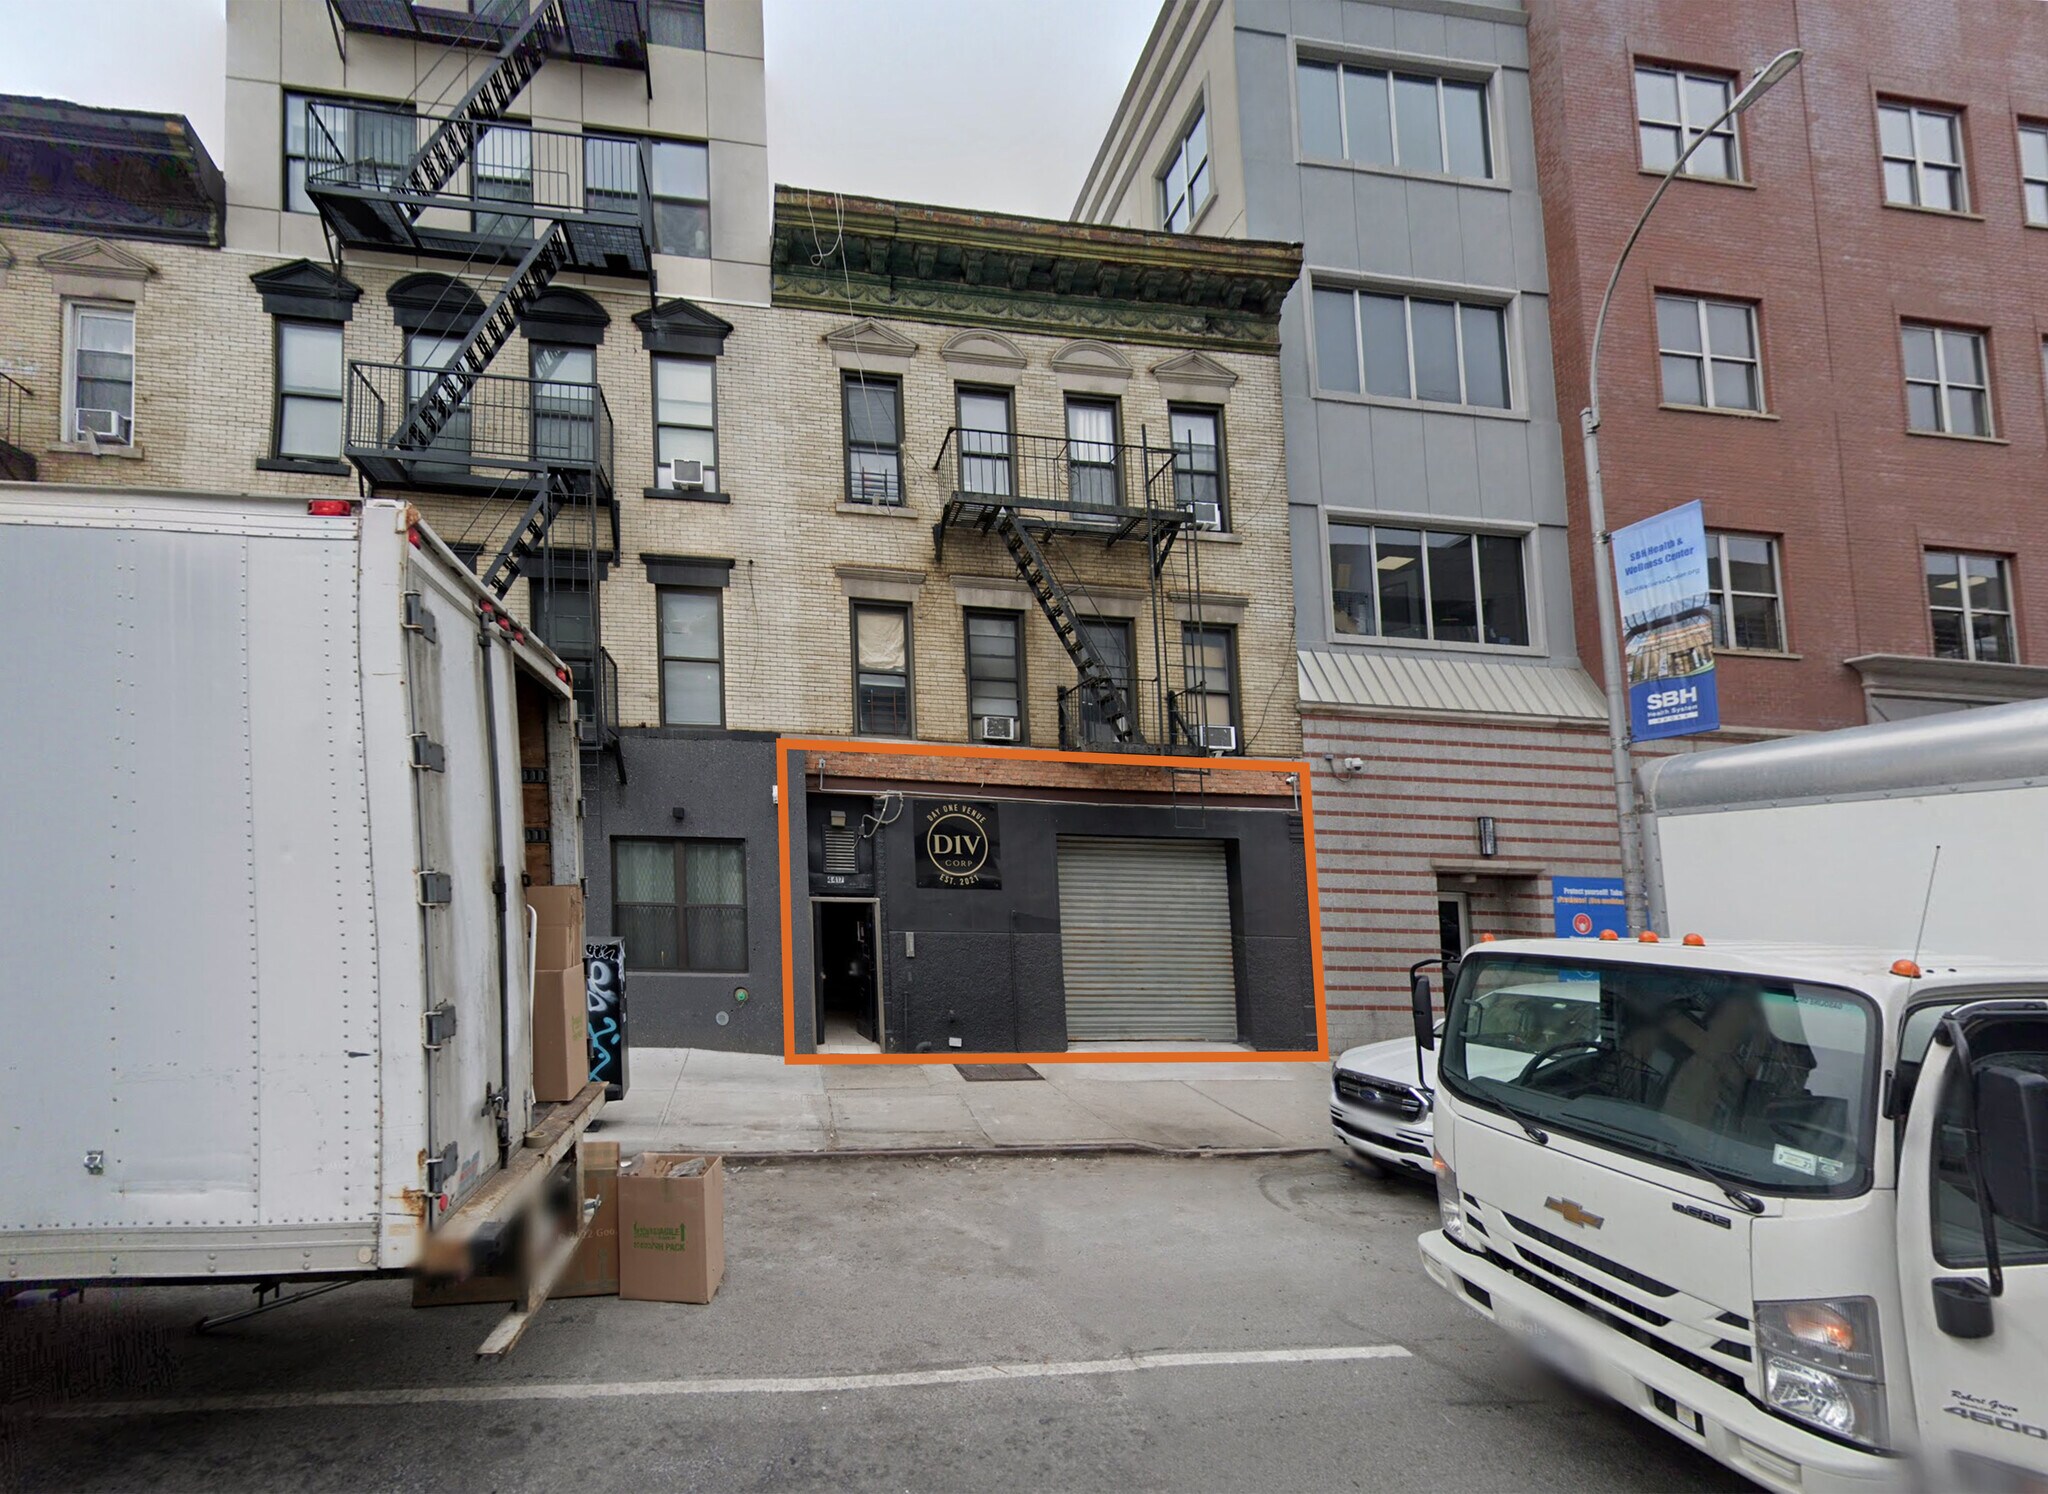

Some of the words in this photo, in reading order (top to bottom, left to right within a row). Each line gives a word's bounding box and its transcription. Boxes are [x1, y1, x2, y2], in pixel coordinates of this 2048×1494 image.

[1647, 539, 1675, 555] Health
[1625, 558, 1663, 576] Wellness
[1664, 547, 1694, 562] Center
[1647, 686, 1698, 710] SBH
[1647, 708, 1670, 718] Health
[1671, 704, 1698, 714] System
[927, 808, 941, 822] DAY
[943, 804, 958, 812] ONE
[962, 805, 986, 823] VENUE
[939, 874, 957, 885] EST.
[960, 874, 979, 886] 2021
[1951, 1390, 1985, 1404] Robert
[1942, 1406, 2048, 1440] 4500
